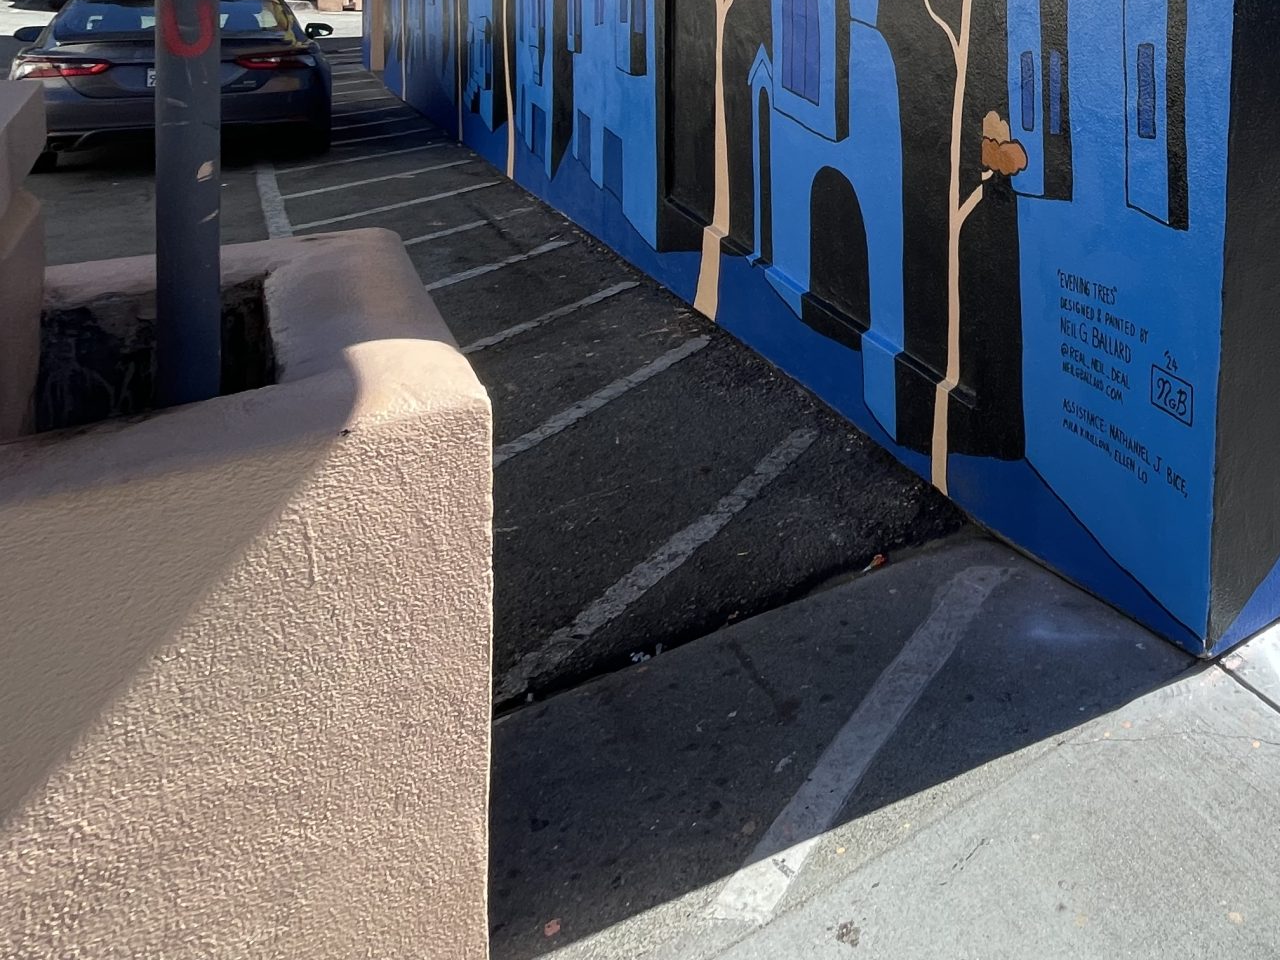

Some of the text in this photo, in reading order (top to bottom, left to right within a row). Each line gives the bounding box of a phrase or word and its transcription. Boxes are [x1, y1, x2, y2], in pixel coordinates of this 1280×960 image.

[1060, 296, 1149, 344] DESIGNED & PAINTED BY
[1060, 316, 1077, 339] NEIL
[1091, 326, 1131, 364] BALLARD
[1109, 423, 1151, 466] NATHANIEL
[1114, 449, 1136, 473] ELLEN
